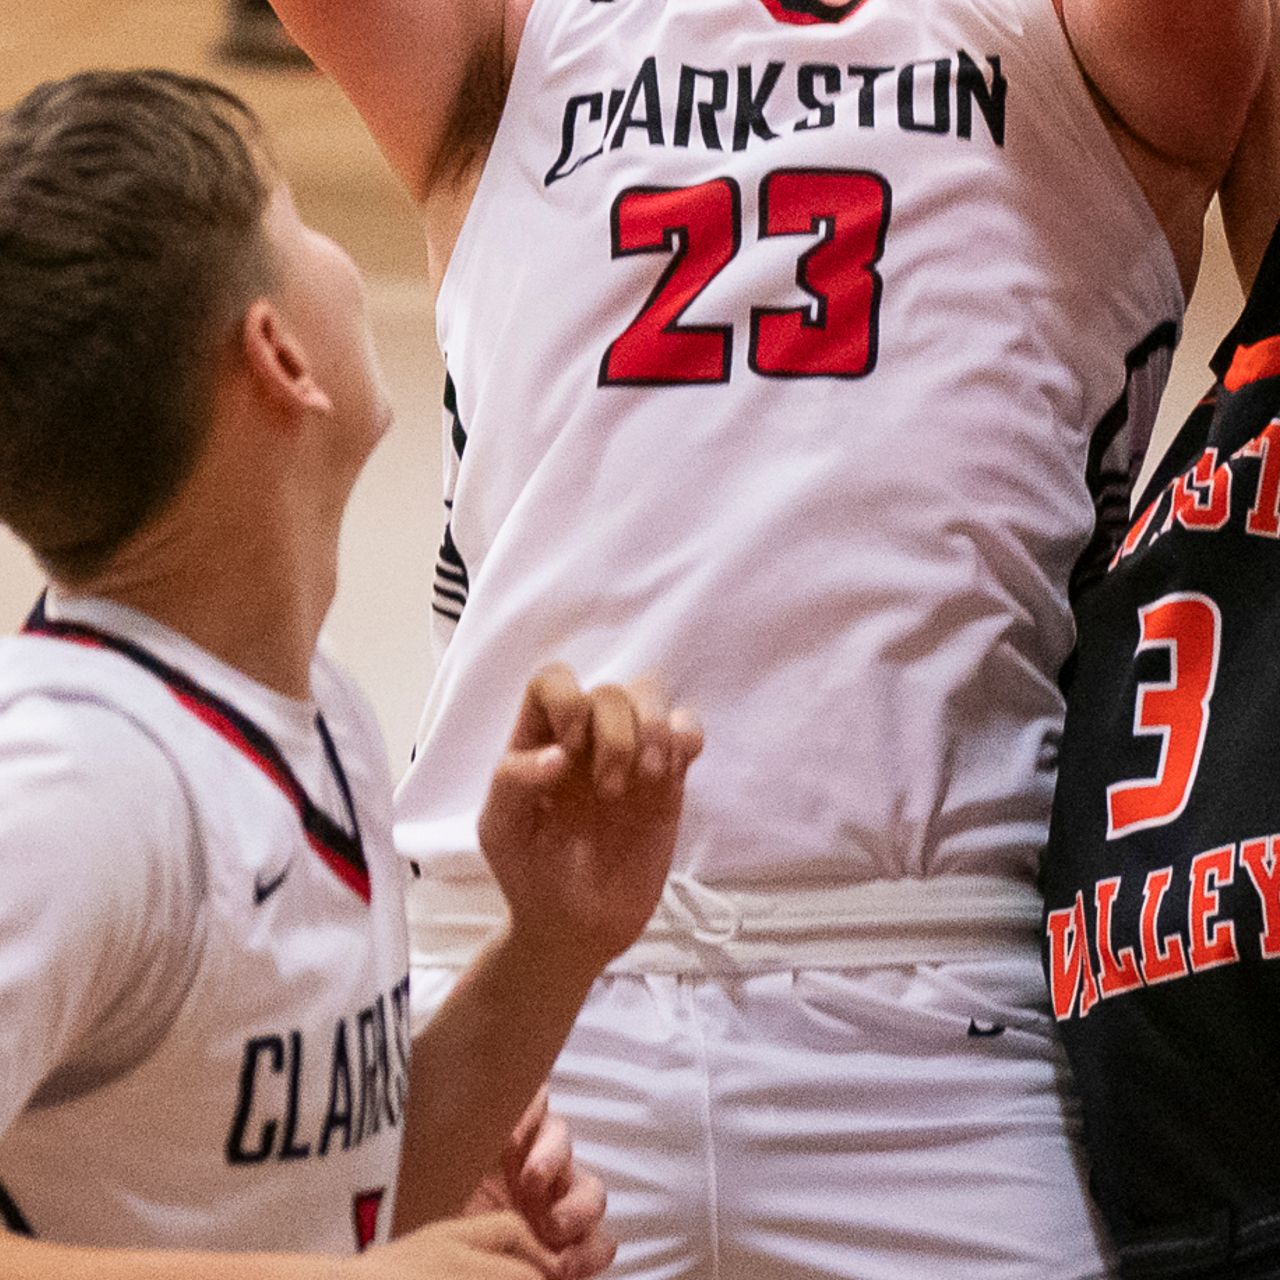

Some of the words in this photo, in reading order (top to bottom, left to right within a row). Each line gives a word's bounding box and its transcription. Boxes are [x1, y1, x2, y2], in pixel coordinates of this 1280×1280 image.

[544, 49, 1008, 188] CLARKSTON
[597, 166, 893, 388] 23
[1105, 591, 1222, 840] 3
